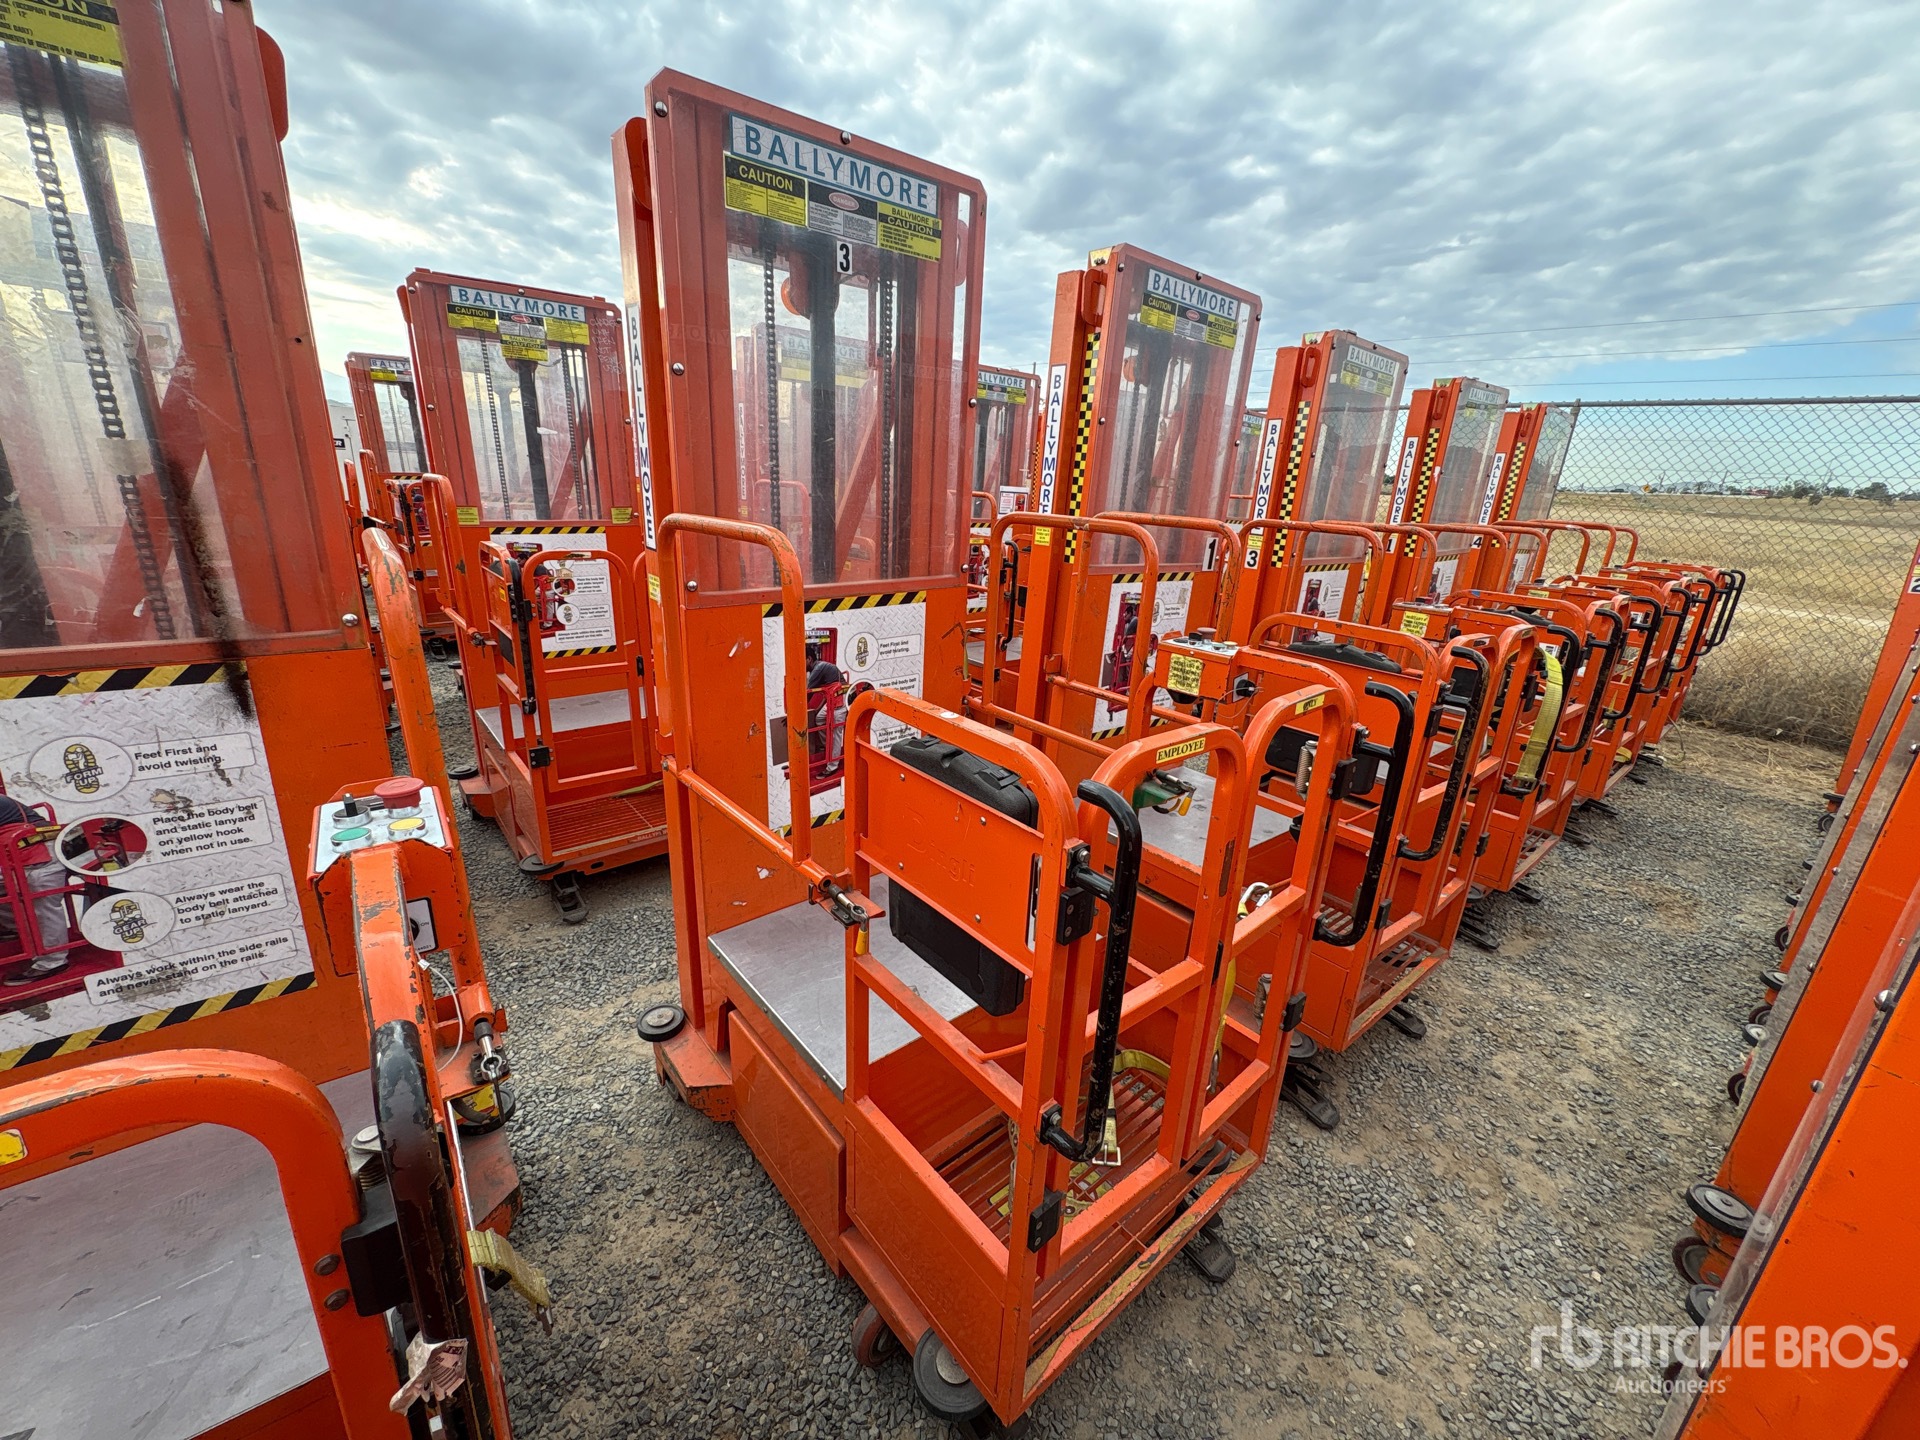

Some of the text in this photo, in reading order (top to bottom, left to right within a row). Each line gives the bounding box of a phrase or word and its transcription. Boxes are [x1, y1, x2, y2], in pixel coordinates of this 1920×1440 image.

[738, 165, 793, 192] CAUTION
[745, 125, 928, 210] BALLYMORE
[887, 216, 933, 236] CAUTION
[891, 207, 930, 225] BALLYMORE
[839, 243, 851, 272] 3
[458, 288, 580, 320] BALLYMORE
[1148, 297, 1172, 312] CAUTION
[1153, 272, 1234, 317] BALLYMORE
[455, 306, 490, 318] CAUTION
[371, 359, 407, 369] BALLY
[1350, 347, 1394, 373] BALLYMORE
[978, 373, 1023, 388] ALLYMORE
[631, 317, 653, 540] BALLYMORE
[1042, 374, 1062, 514] BALLYMORE
[1254, 424, 1277, 529] BALLYMOR
[1392, 440, 1415, 524] BALLYMORE
[1480, 456, 1502, 524] BALLYMORE
[1386, 538, 1393, 552] 1
[1473, 536, 1483, 548] 4
[1207, 538, 1217, 570] 1
[1246, 550, 1258, 567] 3
[134, 744, 218, 760] Feet First and
[1157, 738, 1205, 762] EMPLOYEE
[137, 754, 225, 772] avoid twisting.
[66, 768, 103, 783] FORM
[79, 777, 95, 787] UP
[152, 803, 259, 825] Place the body belt
[155, 814, 256, 836] and static lanyard
[158, 826, 245, 847] on yellow hook
[161, 836, 254, 858] when not in use.
[175, 880, 265, 905] Always wear the
[177, 887, 279, 915] body belt attached
[180, 900, 272, 925] to static lanyard.
[114, 919, 147, 935] GEAR
[126, 927, 142, 938] UP
[96, 936, 290, 987] Always work within the side rails
[99, 951, 269, 997] and never stand on the rails.
